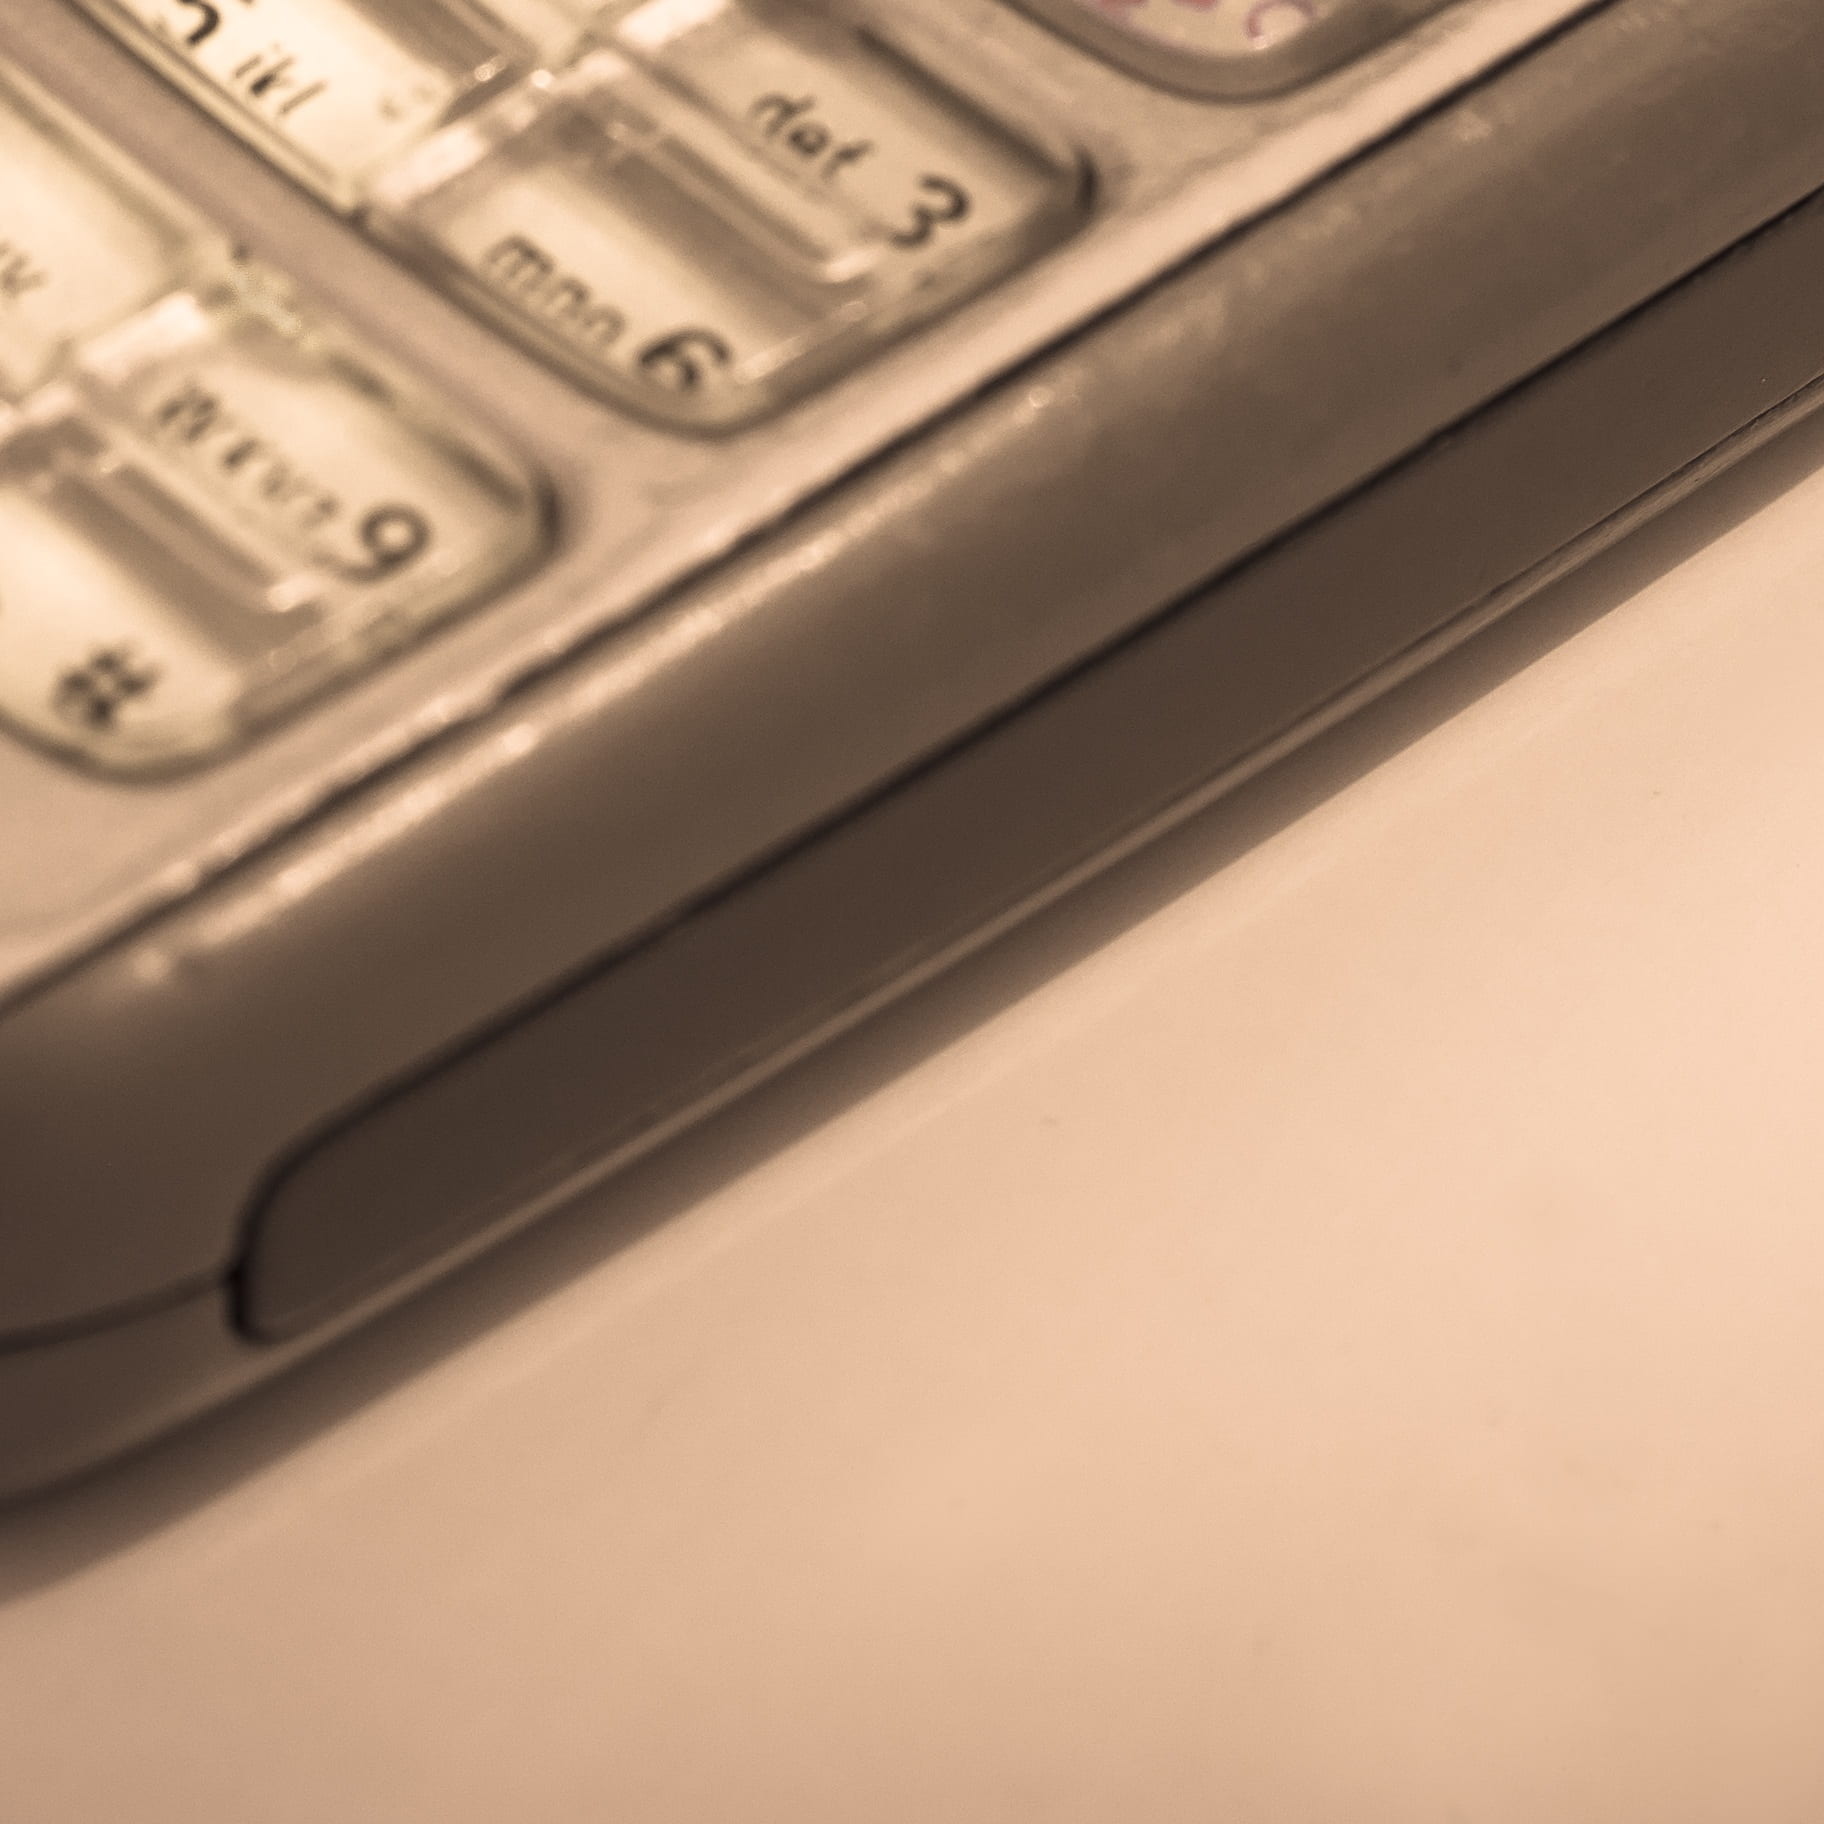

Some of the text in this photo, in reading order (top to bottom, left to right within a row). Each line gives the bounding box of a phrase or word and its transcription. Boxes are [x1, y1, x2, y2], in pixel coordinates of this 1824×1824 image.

[888, 176, 972, 250] 3
[634, 326, 736, 396] 6
[340, 502, 432, 584] 9
